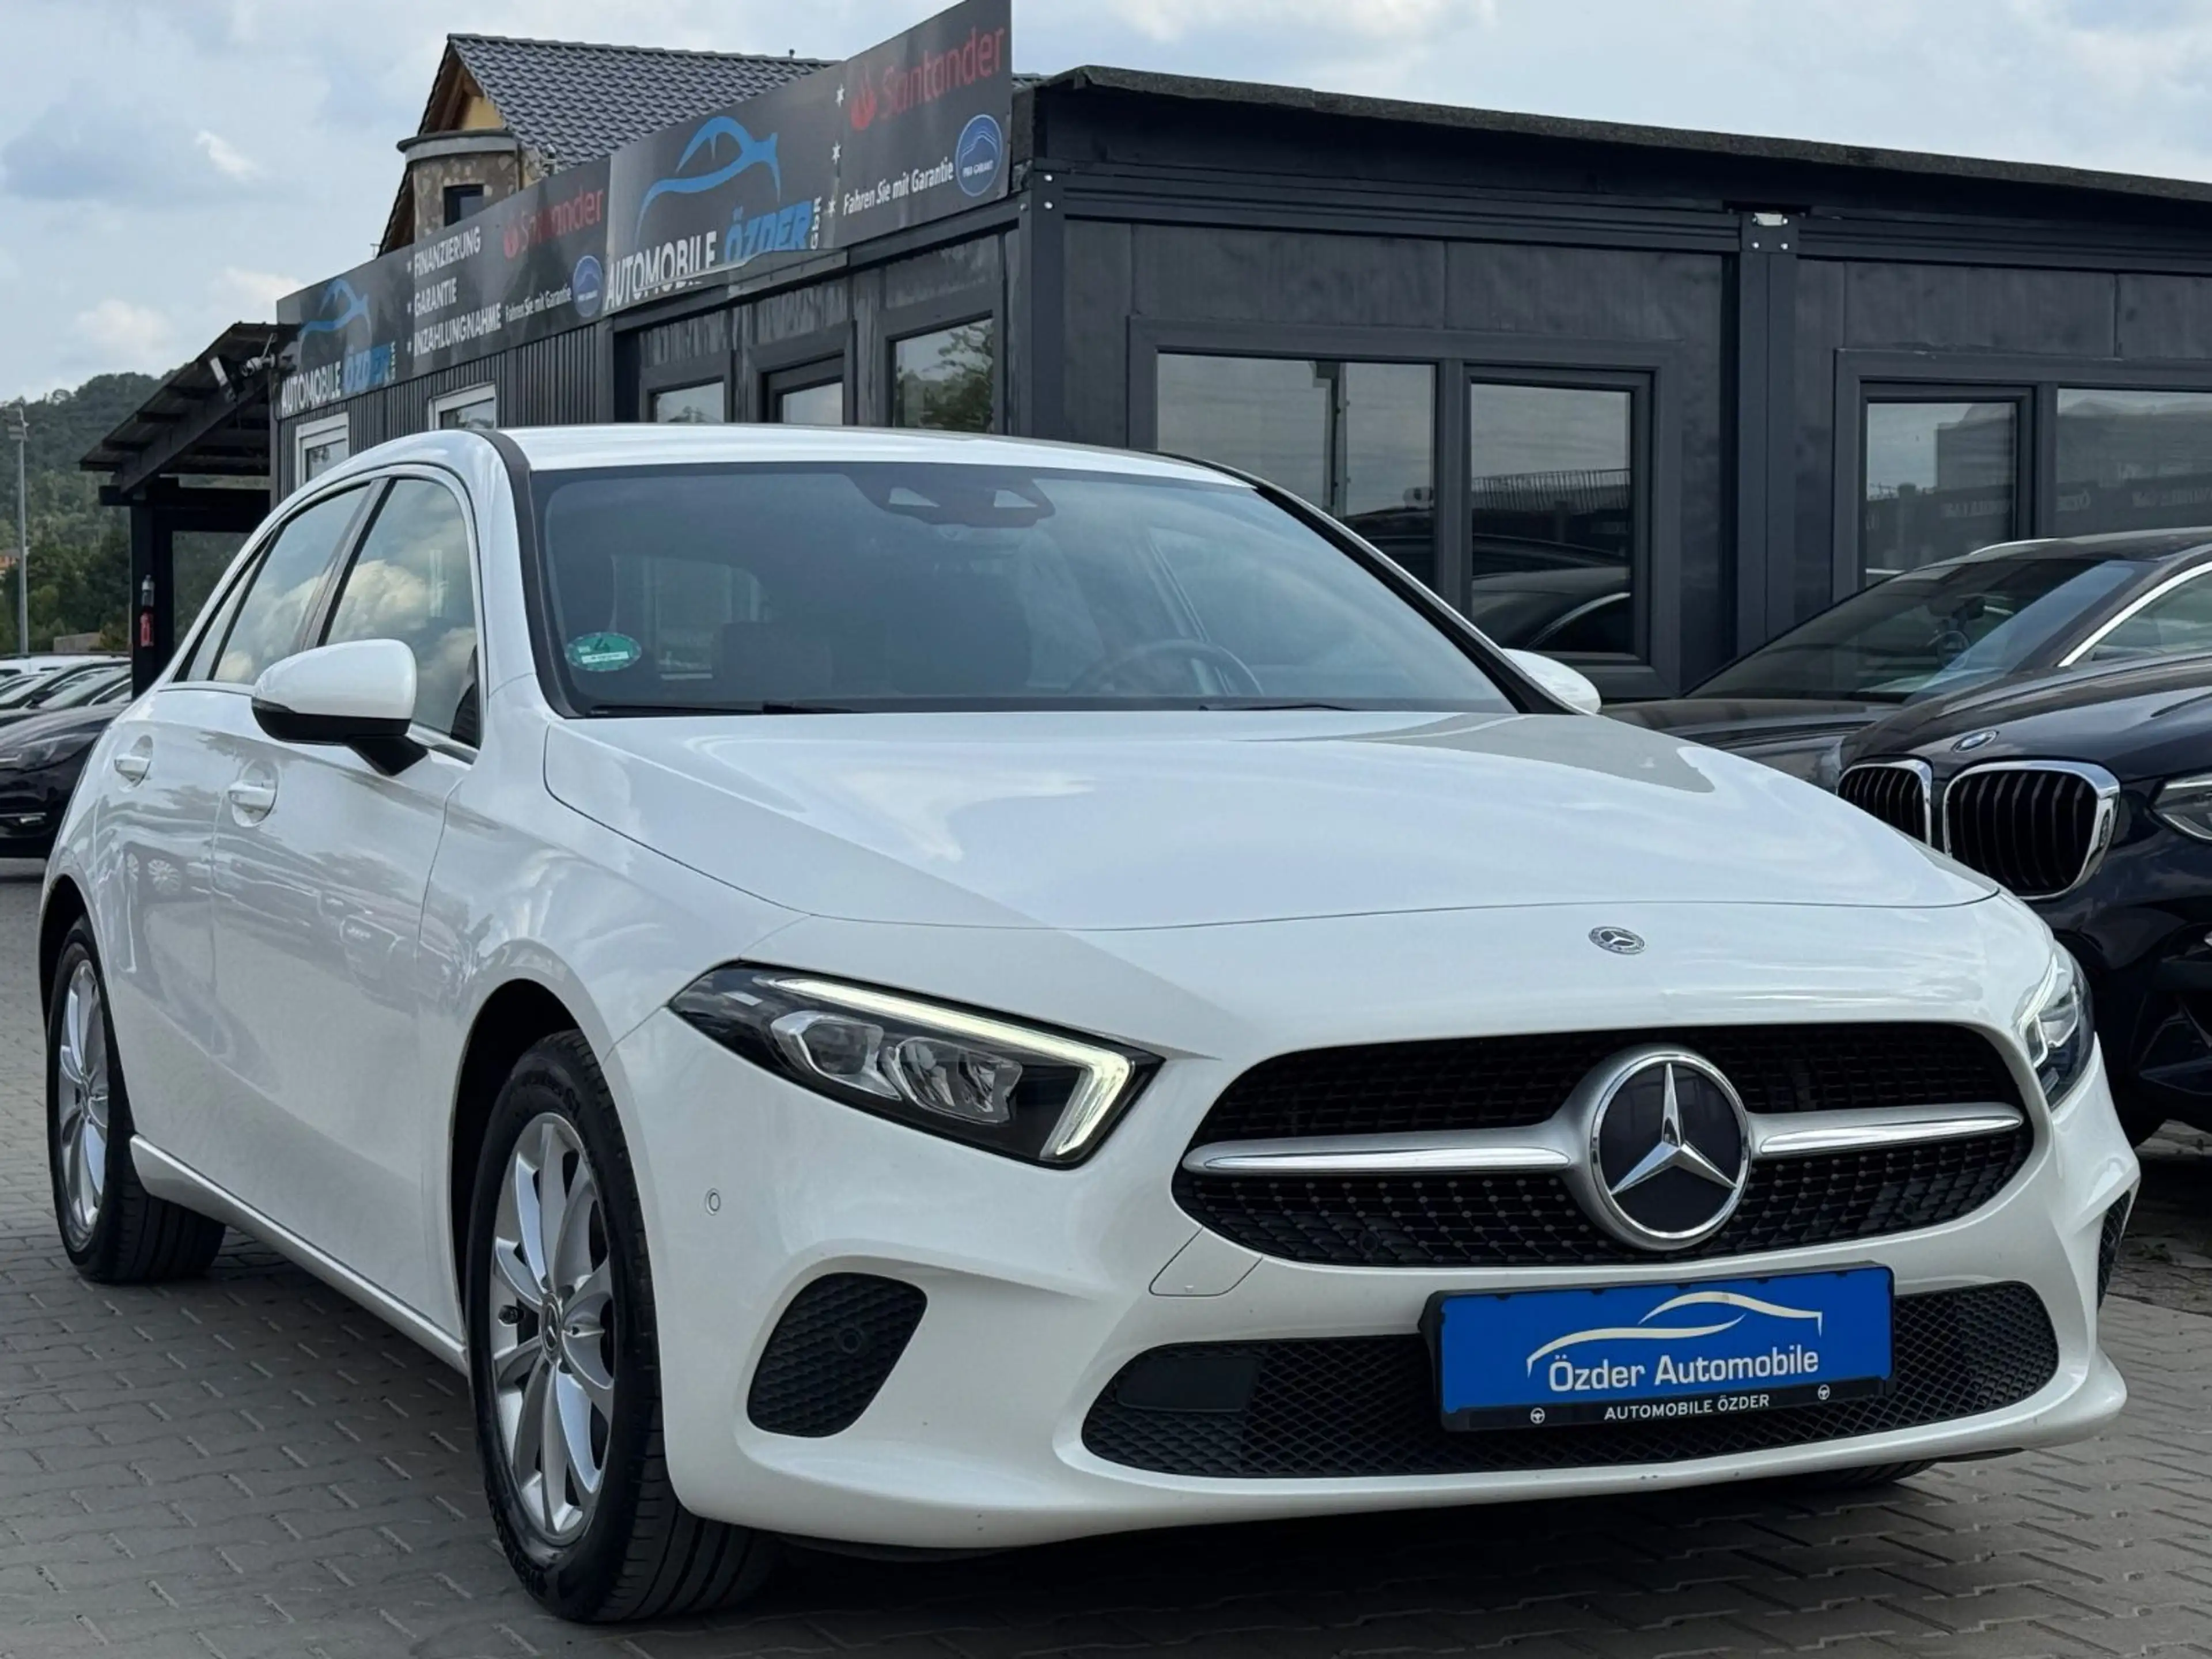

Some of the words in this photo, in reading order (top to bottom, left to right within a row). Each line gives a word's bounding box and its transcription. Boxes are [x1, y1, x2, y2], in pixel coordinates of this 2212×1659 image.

[880, 26, 1005, 122] Santander
[843, 188, 876, 217] Fahren
[876, 178, 892, 204] Sie
[892, 171, 910, 199] mit
[911, 156, 955, 193] Garantie
[414, 225, 482, 279] FINANZIERUNG
[605, 230, 717, 312] AUTOMOBILE
[414, 277, 457, 318] GARANTIE
[414, 302, 502, 357] INZAHLUNGNAHME
[281, 360, 342, 419] AUTOMOBILE
[1549, 1354, 1646, 1392] Özder
[1654, 1344, 1819, 1386] Automobile
[1604, 1400, 1713, 1421] AUTOMOBILE
[1717, 1394, 1770, 1412] ÖZDER
